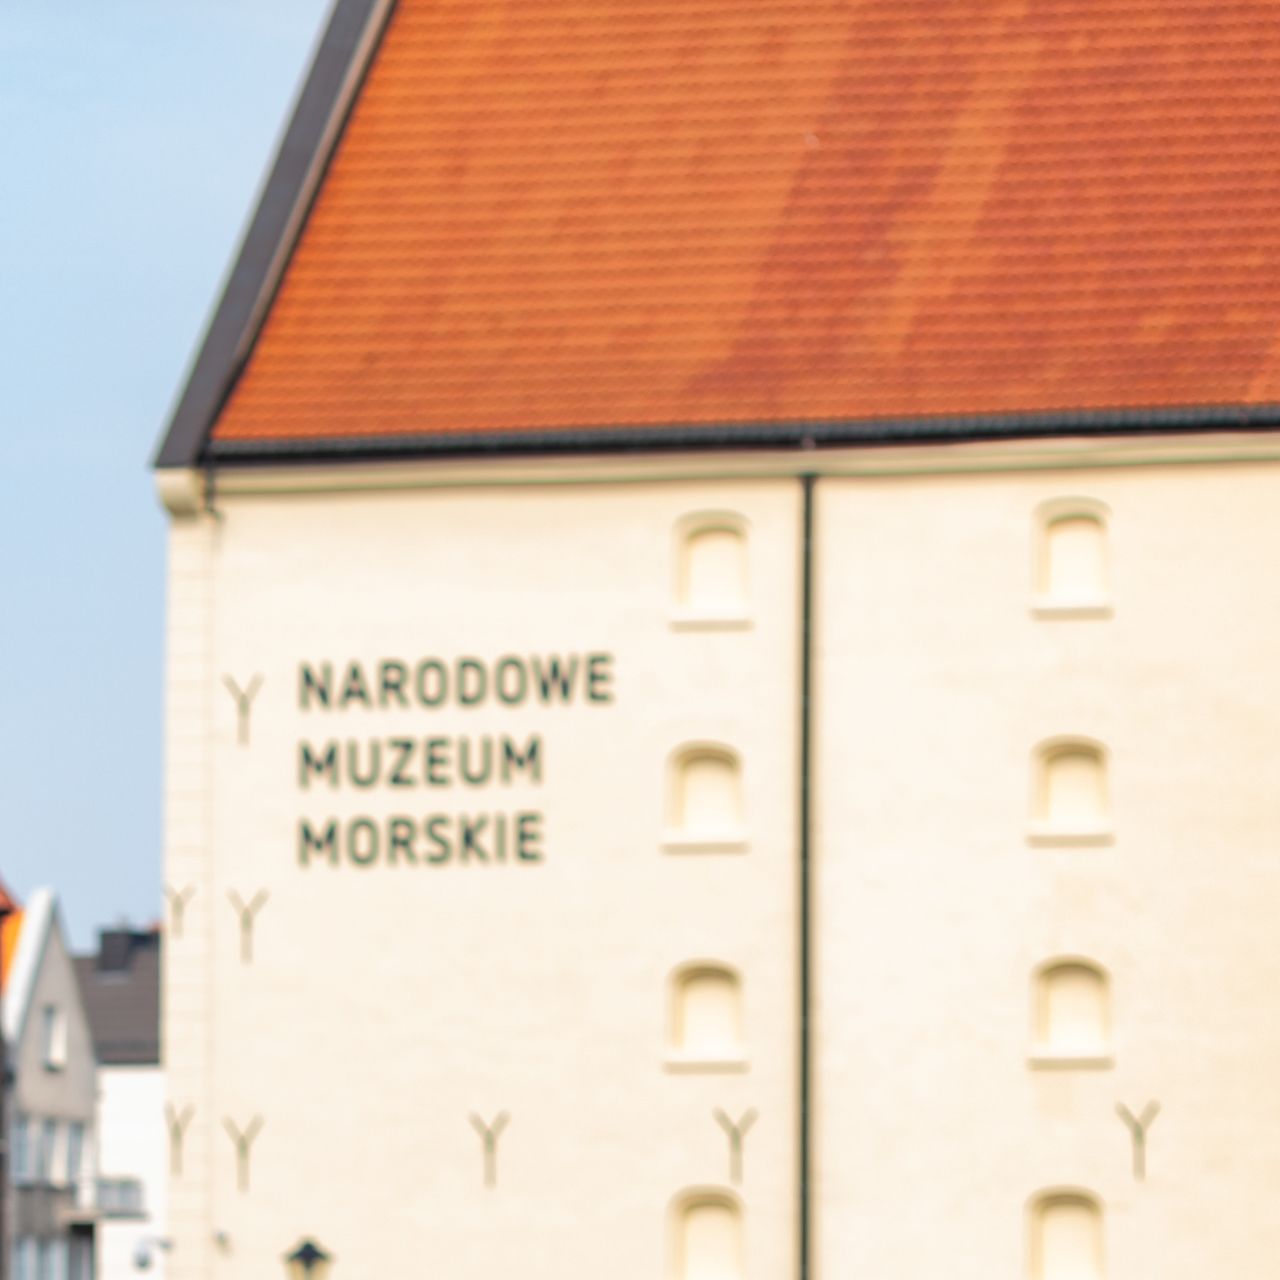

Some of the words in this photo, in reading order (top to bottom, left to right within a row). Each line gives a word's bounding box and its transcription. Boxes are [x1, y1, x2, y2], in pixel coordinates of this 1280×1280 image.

[298, 653, 614, 709] NARODOWE
[298, 734, 542, 789] MUZEUM
[298, 810, 542, 867] MORSKIE
